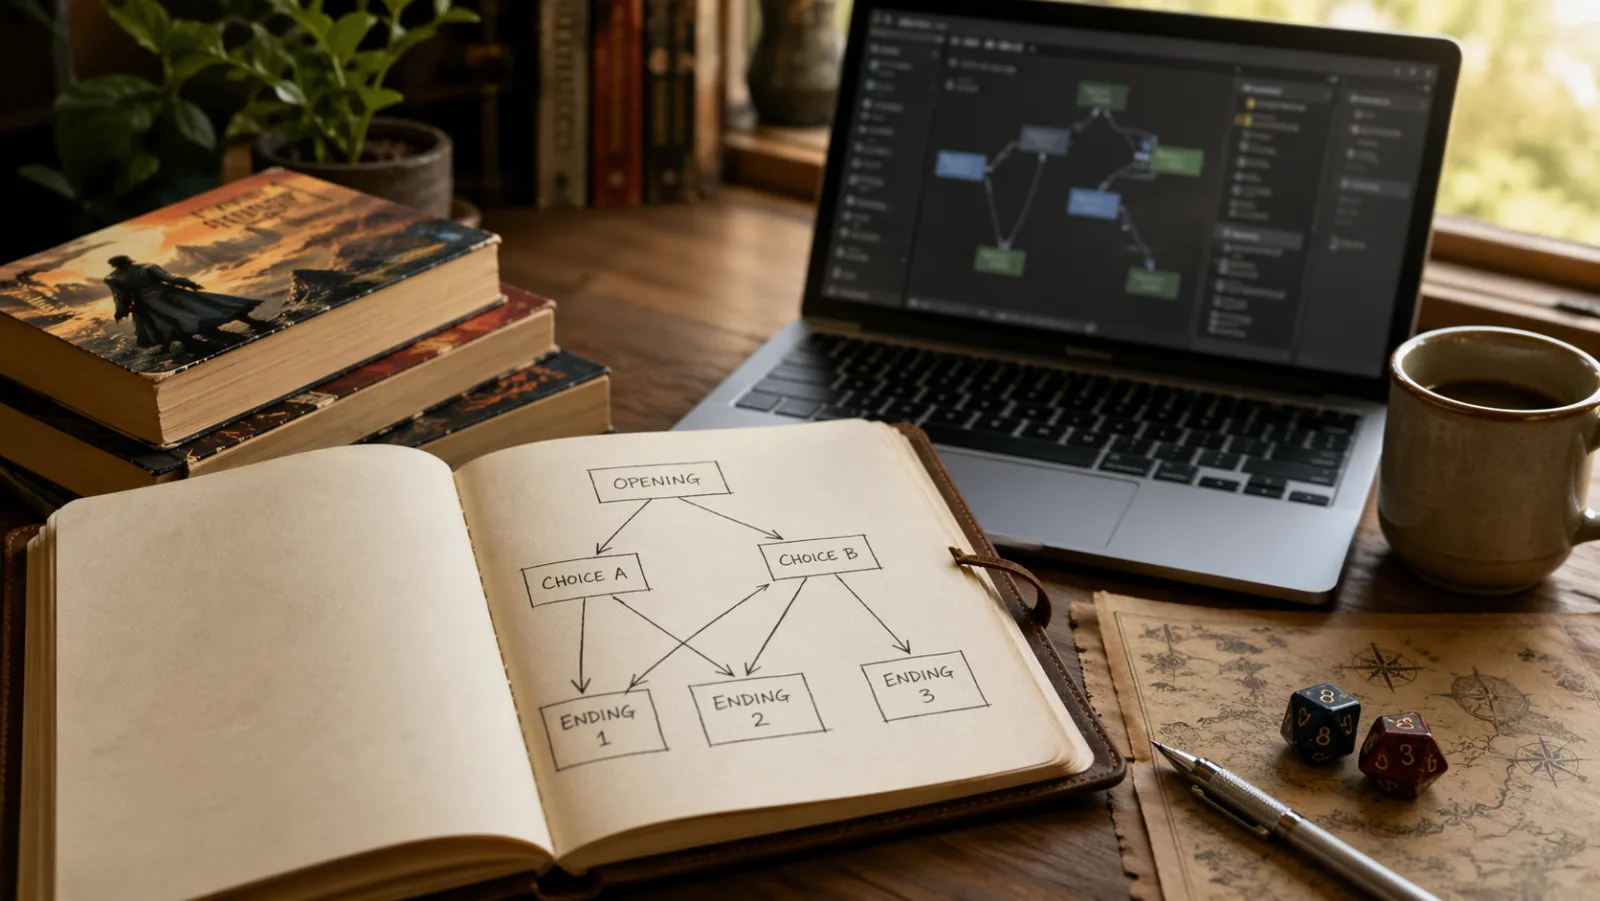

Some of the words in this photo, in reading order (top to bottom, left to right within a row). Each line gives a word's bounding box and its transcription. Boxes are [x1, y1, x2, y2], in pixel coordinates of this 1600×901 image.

[613, 472, 701, 490] OPENING
[778, 549, 839, 567] CHOICE
[842, 547, 859, 561] B
[541, 570, 606, 590] CHOICE
[614, 566, 628, 581] A
[883, 665, 954, 688] ENDING
[712, 688, 791, 711] ENDING
[918, 688, 936, 704] 3
[1320, 689, 1335, 703] 8
[560, 704, 636, 731] ENDING
[751, 711, 771, 728] 2
[596, 730, 611, 747] 1
[1316, 726, 1331, 746] 8
[1400, 743, 1415, 766] 3
